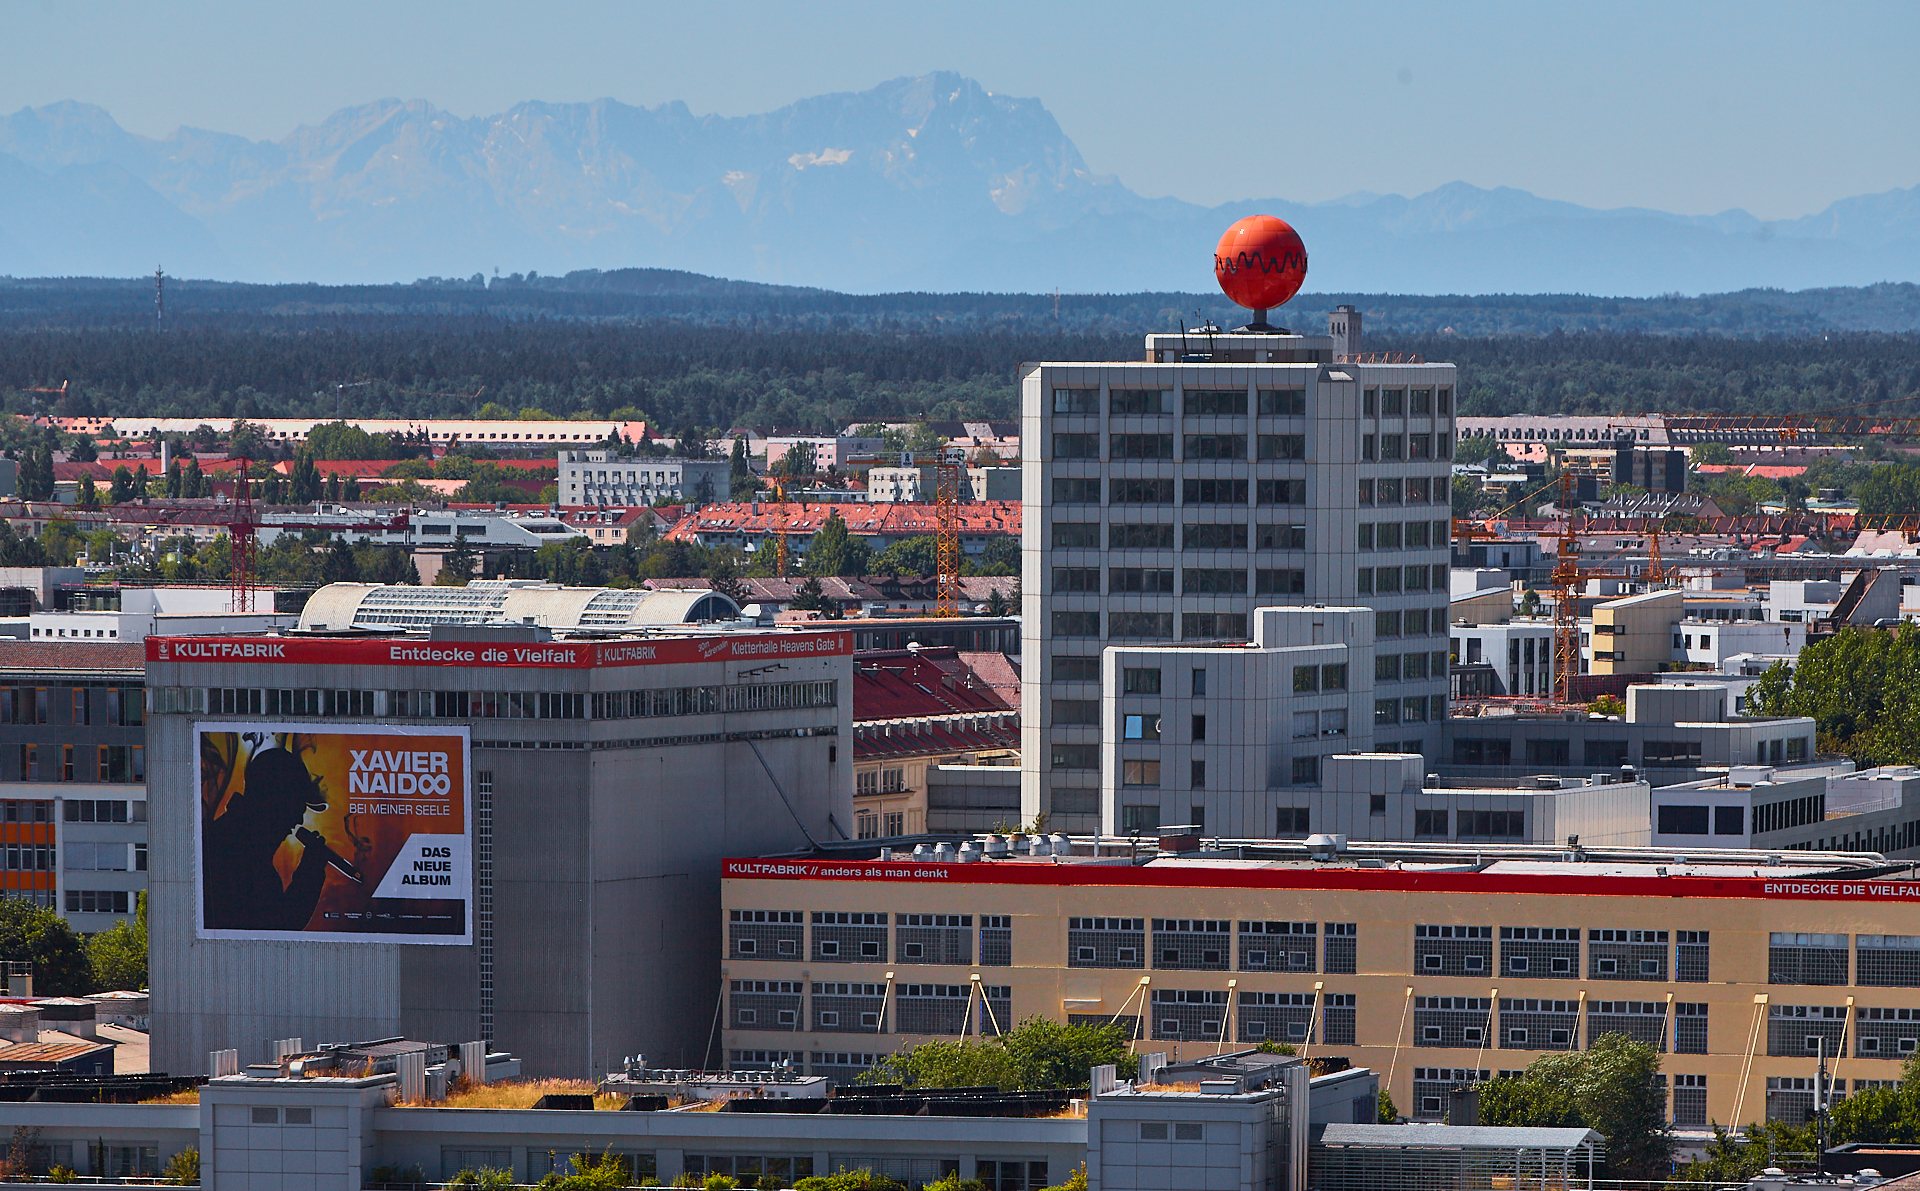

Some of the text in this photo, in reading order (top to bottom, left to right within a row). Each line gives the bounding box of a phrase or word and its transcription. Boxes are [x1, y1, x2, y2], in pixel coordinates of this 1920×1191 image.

[175, 643, 285, 658] KULTFABRIK
[604, 646, 656, 661] KULTFABRIK
[732, 641, 777, 655] Kletterhalle
[780, 640, 814, 652] Heavens
[816, 638, 835, 651] Gate
[390, 646, 576, 664] Entdecke die Vielfalt
[349, 750, 448, 773] XAVIER
[350, 803, 450, 816] BEI MEINER SEELE
[422, 847, 451, 858] DAS
[413, 861, 451, 872] NEUE
[729, 863, 807, 875] KULTFABRIK
[820, 866, 862, 877] anders
[865, 867, 882, 877] als
[885, 869, 911, 877] man
[914, 868, 948, 878] denkt
[401, 874, 451, 886] ALBUM
[1764, 883, 1839, 894] ENTDECKE
[1842, 884, 1865, 895] DIE
